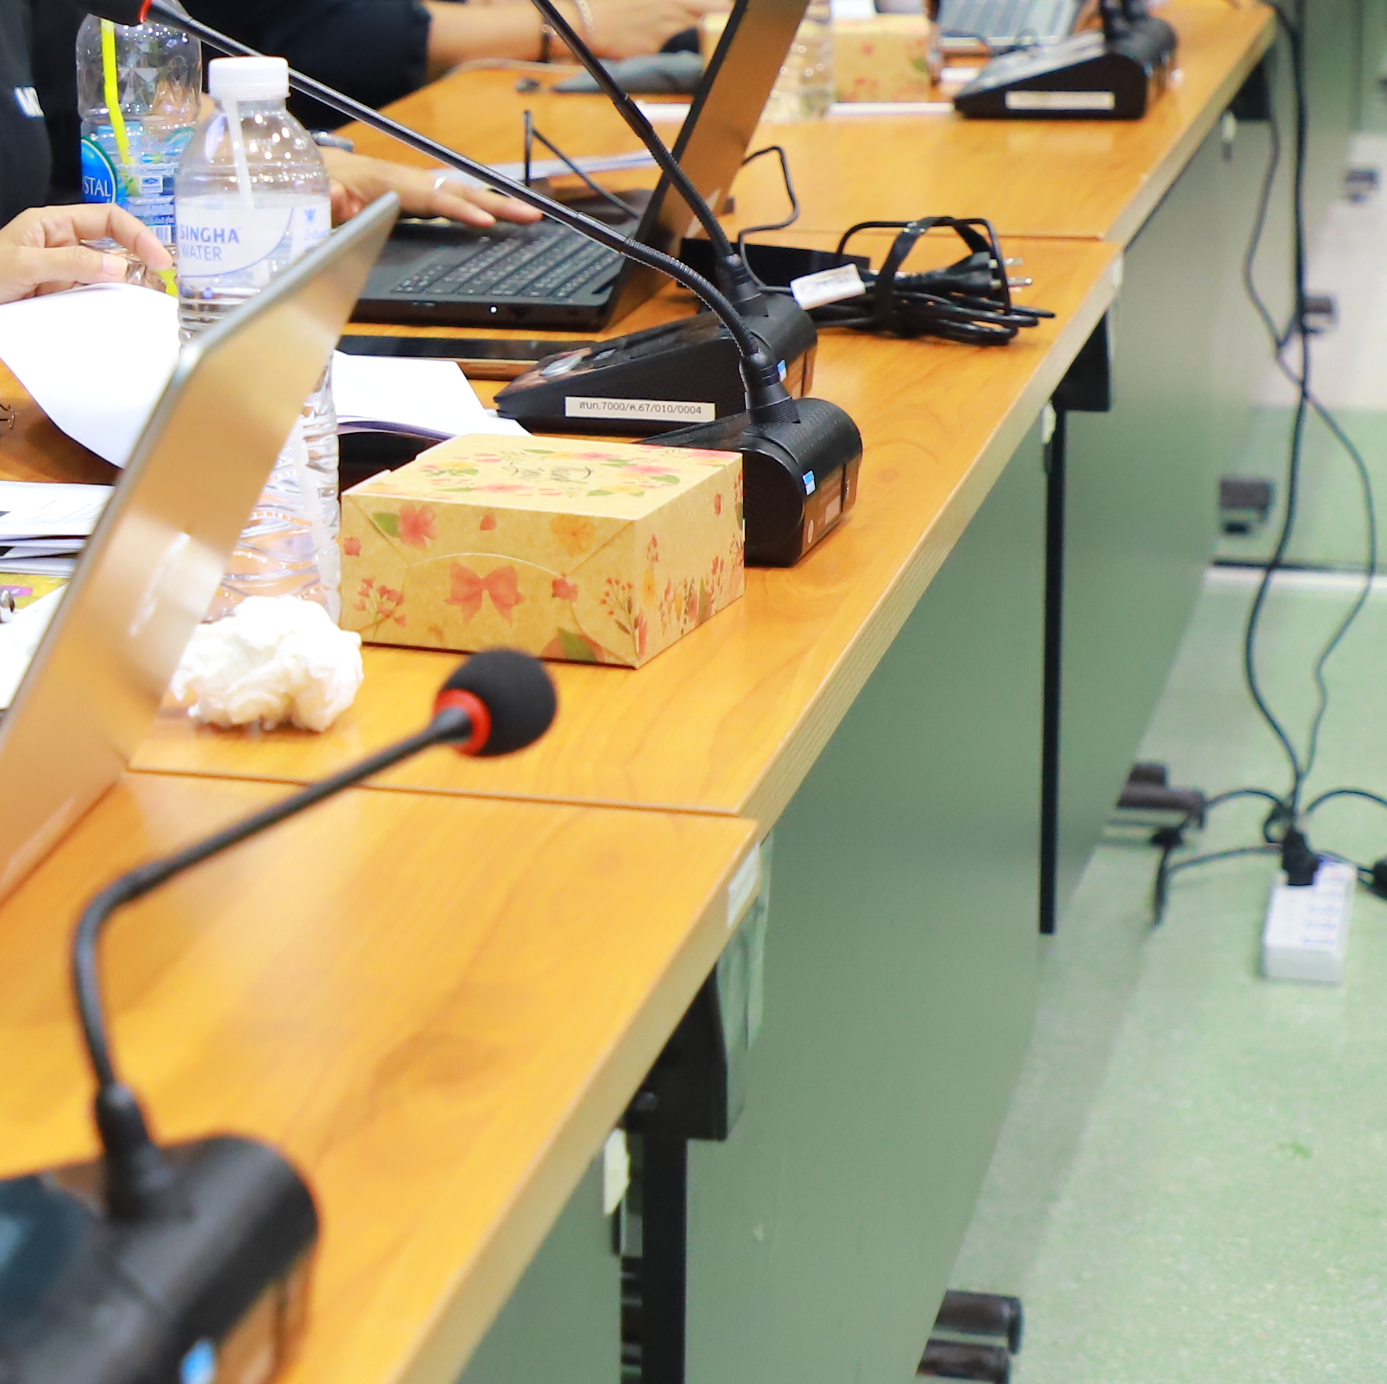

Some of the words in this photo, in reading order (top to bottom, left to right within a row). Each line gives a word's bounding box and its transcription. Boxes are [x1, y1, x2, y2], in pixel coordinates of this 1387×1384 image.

[82, 176, 111, 197] STAL
[179, 226, 240, 244] SINGHA
[180, 244, 223, 262] WATER
